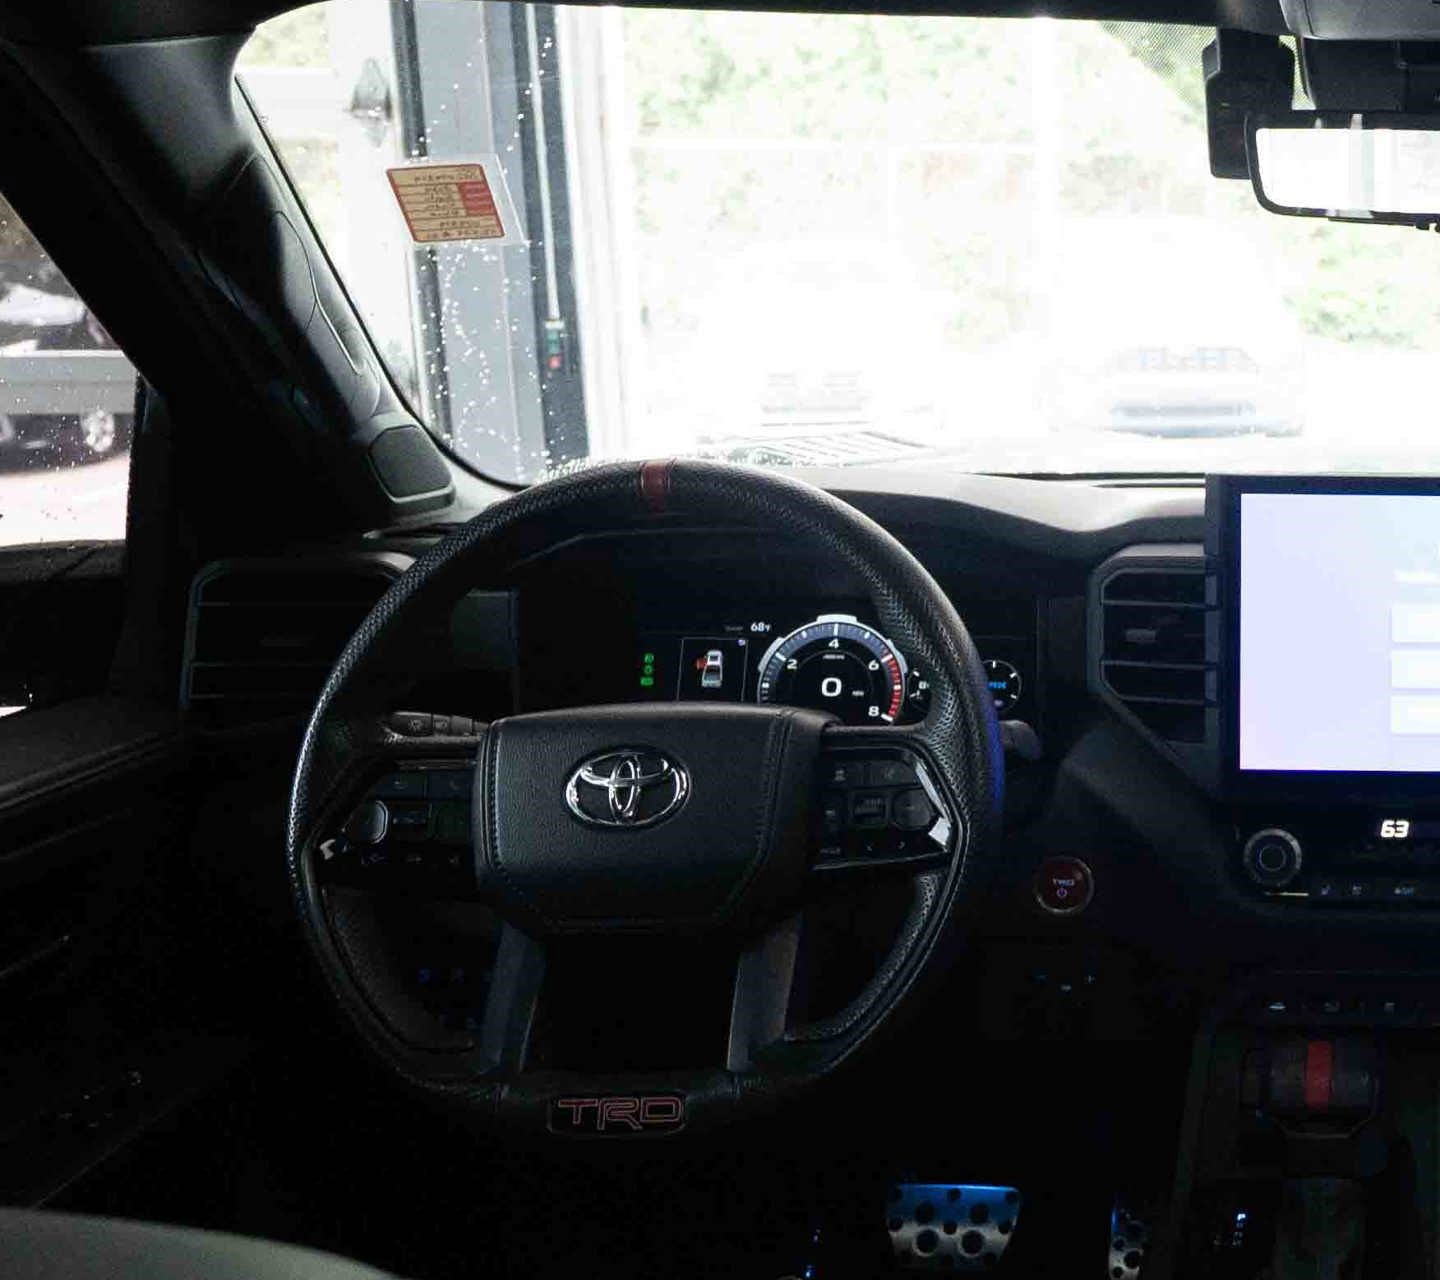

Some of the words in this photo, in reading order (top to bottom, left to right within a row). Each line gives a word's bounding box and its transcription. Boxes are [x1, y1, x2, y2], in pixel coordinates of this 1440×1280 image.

[828, 638, 839, 649] 4
[786, 658, 798, 670] 2
[868, 660, 879, 671] 6
[868, 706, 879, 717] 8
[1380, 819, 1410, 839] 63
[558, 1095, 684, 1132] TRD
